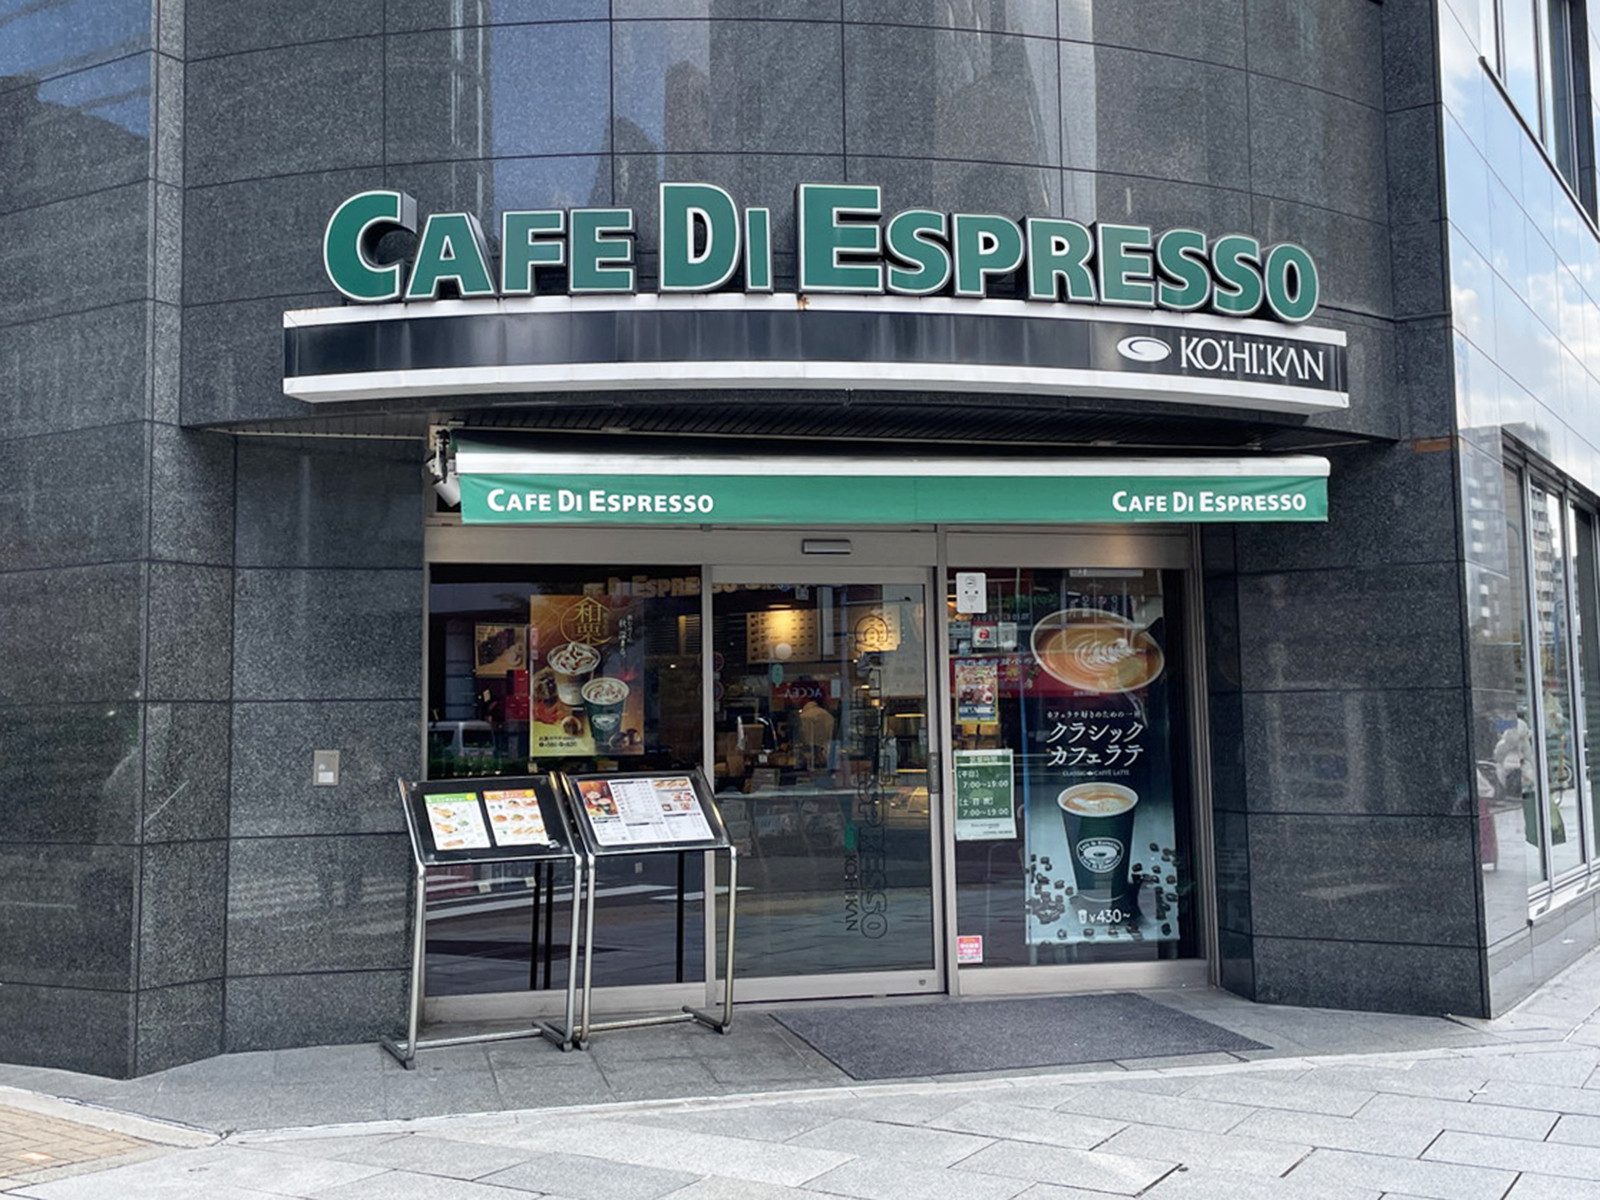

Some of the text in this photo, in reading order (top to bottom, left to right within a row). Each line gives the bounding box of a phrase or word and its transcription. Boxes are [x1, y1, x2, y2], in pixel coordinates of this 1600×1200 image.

[324, 181, 1320, 324] CAFE DI ESPRESSO
[487, 488, 714, 513] CAFE DI ESPRESSO
[1112, 490, 1307, 513] CAFE DI ESPRESSO
[1046, 721, 1144, 744] クラシック
[1047, 744, 1144, 767] カフェラテ
